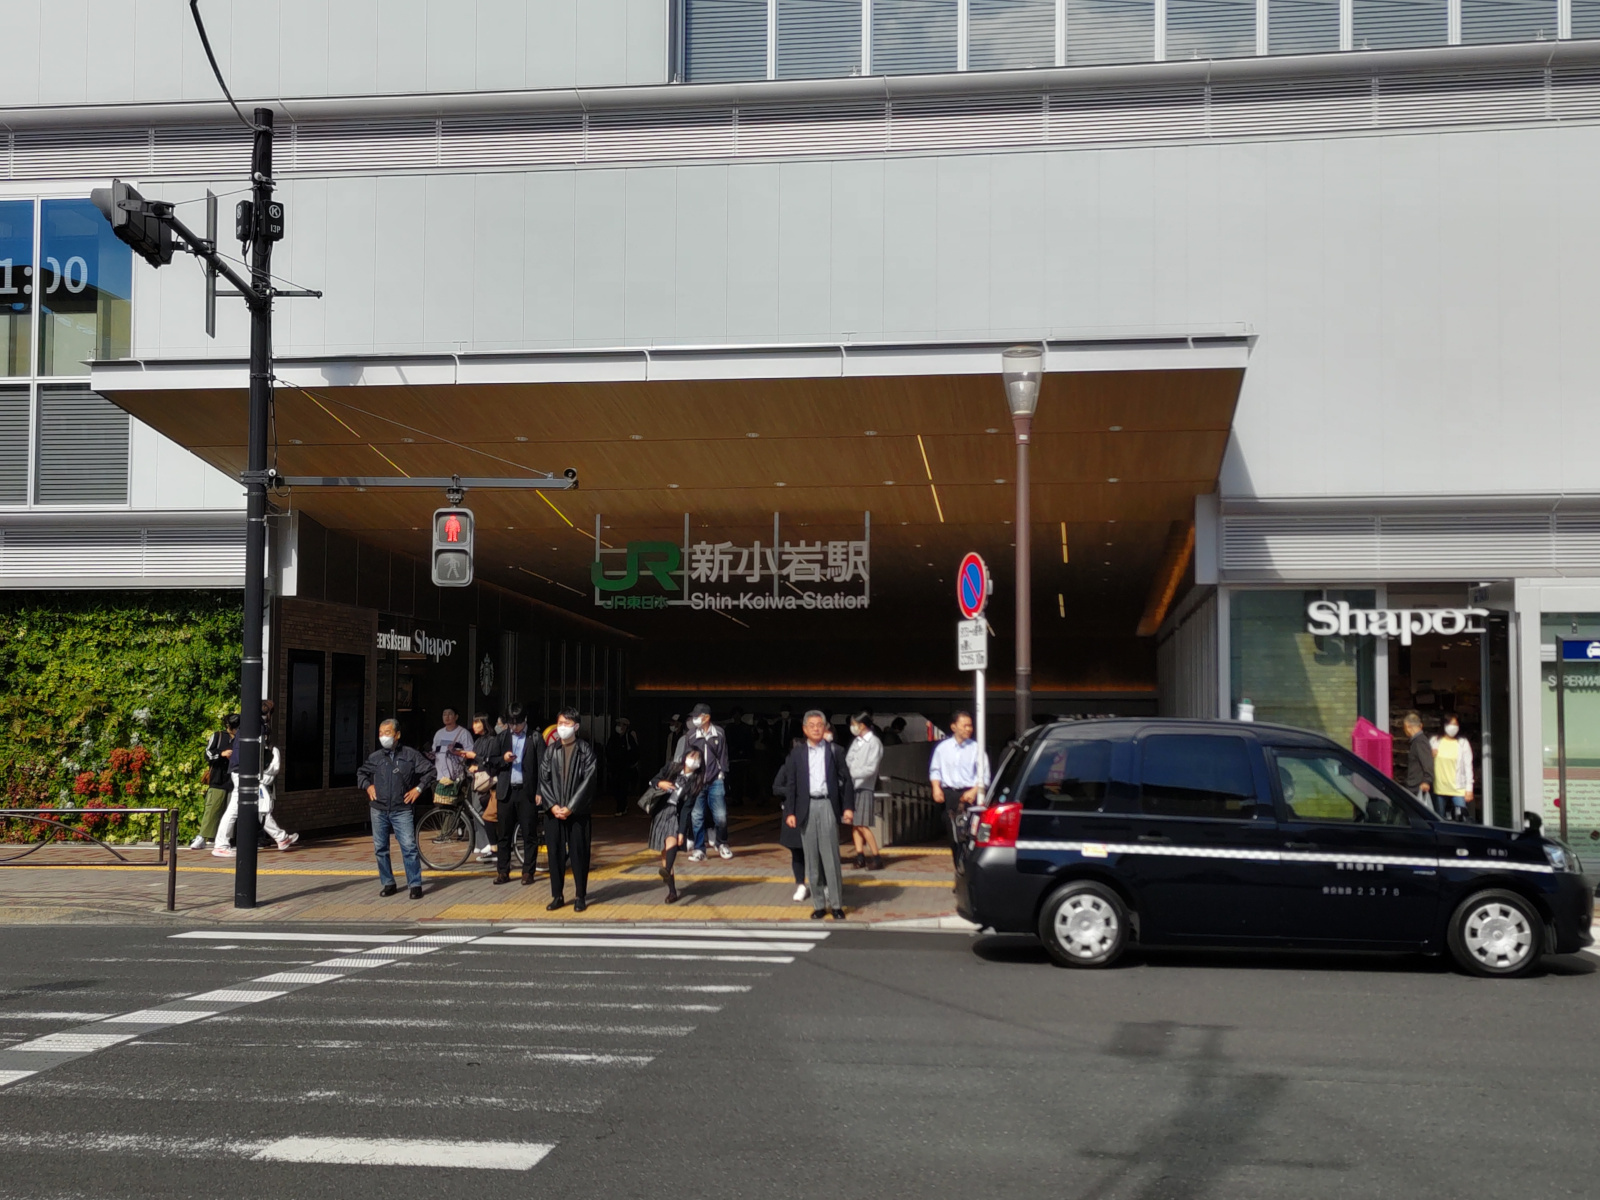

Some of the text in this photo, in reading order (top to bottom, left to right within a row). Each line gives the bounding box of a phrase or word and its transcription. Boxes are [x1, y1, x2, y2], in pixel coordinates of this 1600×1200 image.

[591, 541, 681, 591] JR
[690, 540, 870, 583] 新小岩駅
[602, 595, 669, 610] JR東日本
[690, 592, 869, 610] Shin-Koiwa Station
